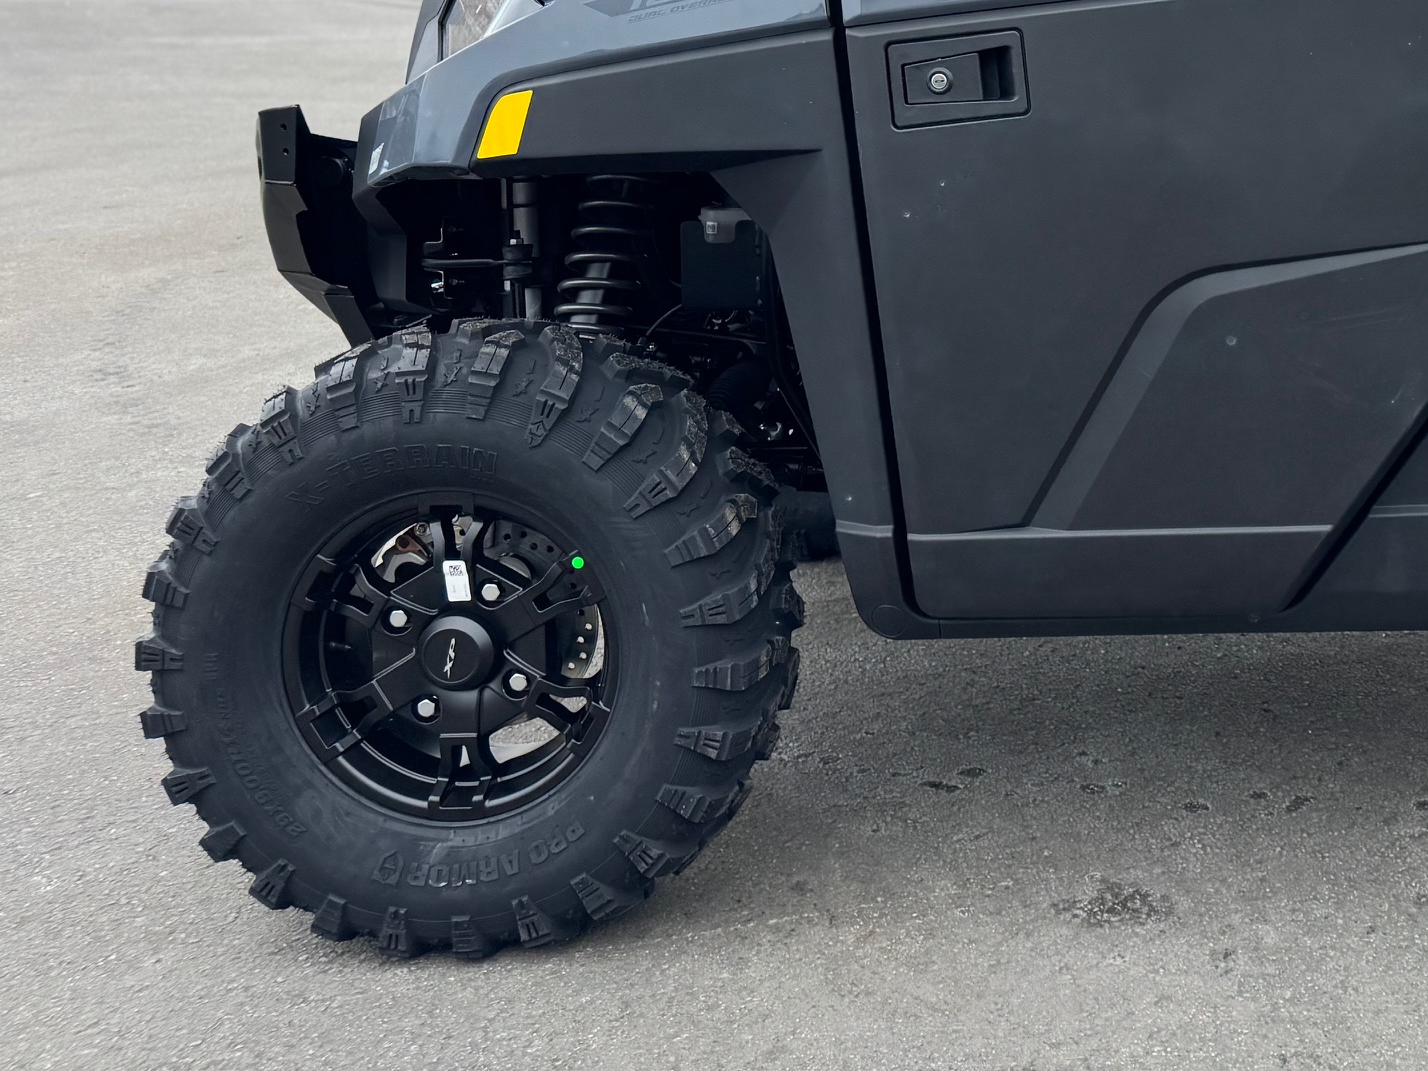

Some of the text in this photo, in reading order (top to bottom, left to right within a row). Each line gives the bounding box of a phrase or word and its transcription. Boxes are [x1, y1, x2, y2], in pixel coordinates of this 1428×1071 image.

[628, 9, 666, 23] DUAL
[284, 442, 498, 515] X-TERRAIN
[406, 820, 586, 888] PRO ARMOR
